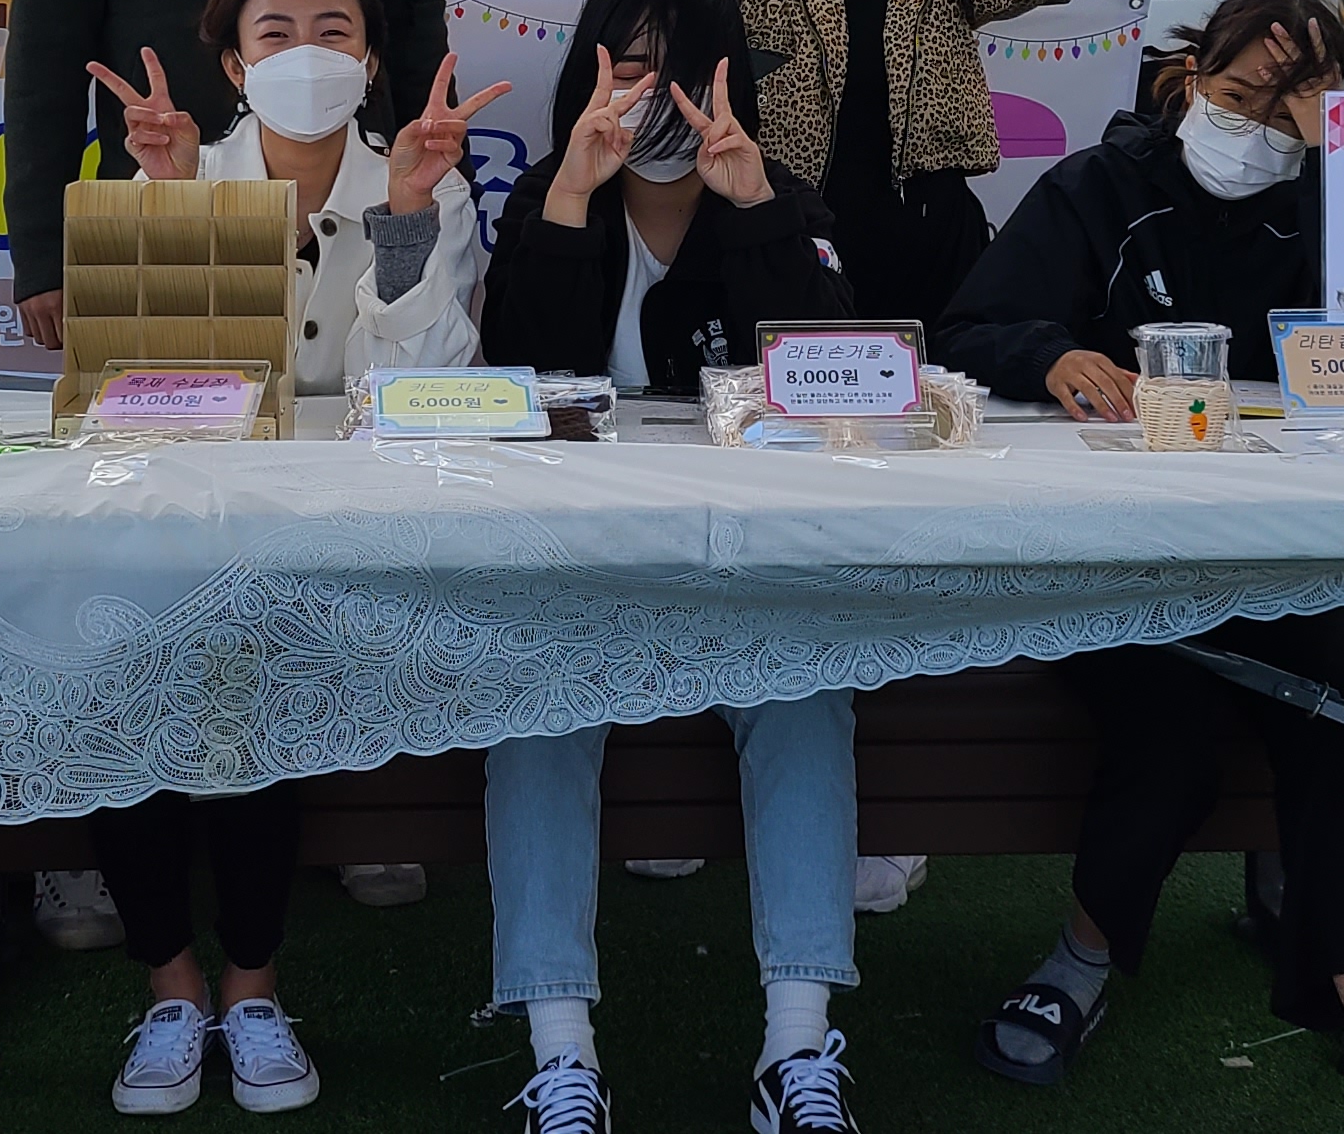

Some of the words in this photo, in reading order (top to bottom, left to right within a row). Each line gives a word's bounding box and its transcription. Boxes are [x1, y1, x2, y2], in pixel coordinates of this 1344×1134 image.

[1299, 334, 1334, 350] 라탄
[786, 344, 824, 361] 라탄
[827, 344, 883, 361] 손거울
[785, 368, 860, 387] 8,000원
[408, 382, 446, 393] 카드
[454, 382, 490, 393] 지갑
[117, 394, 203, 409] 10,000원
[408, 397, 482, 409] 6,000원
